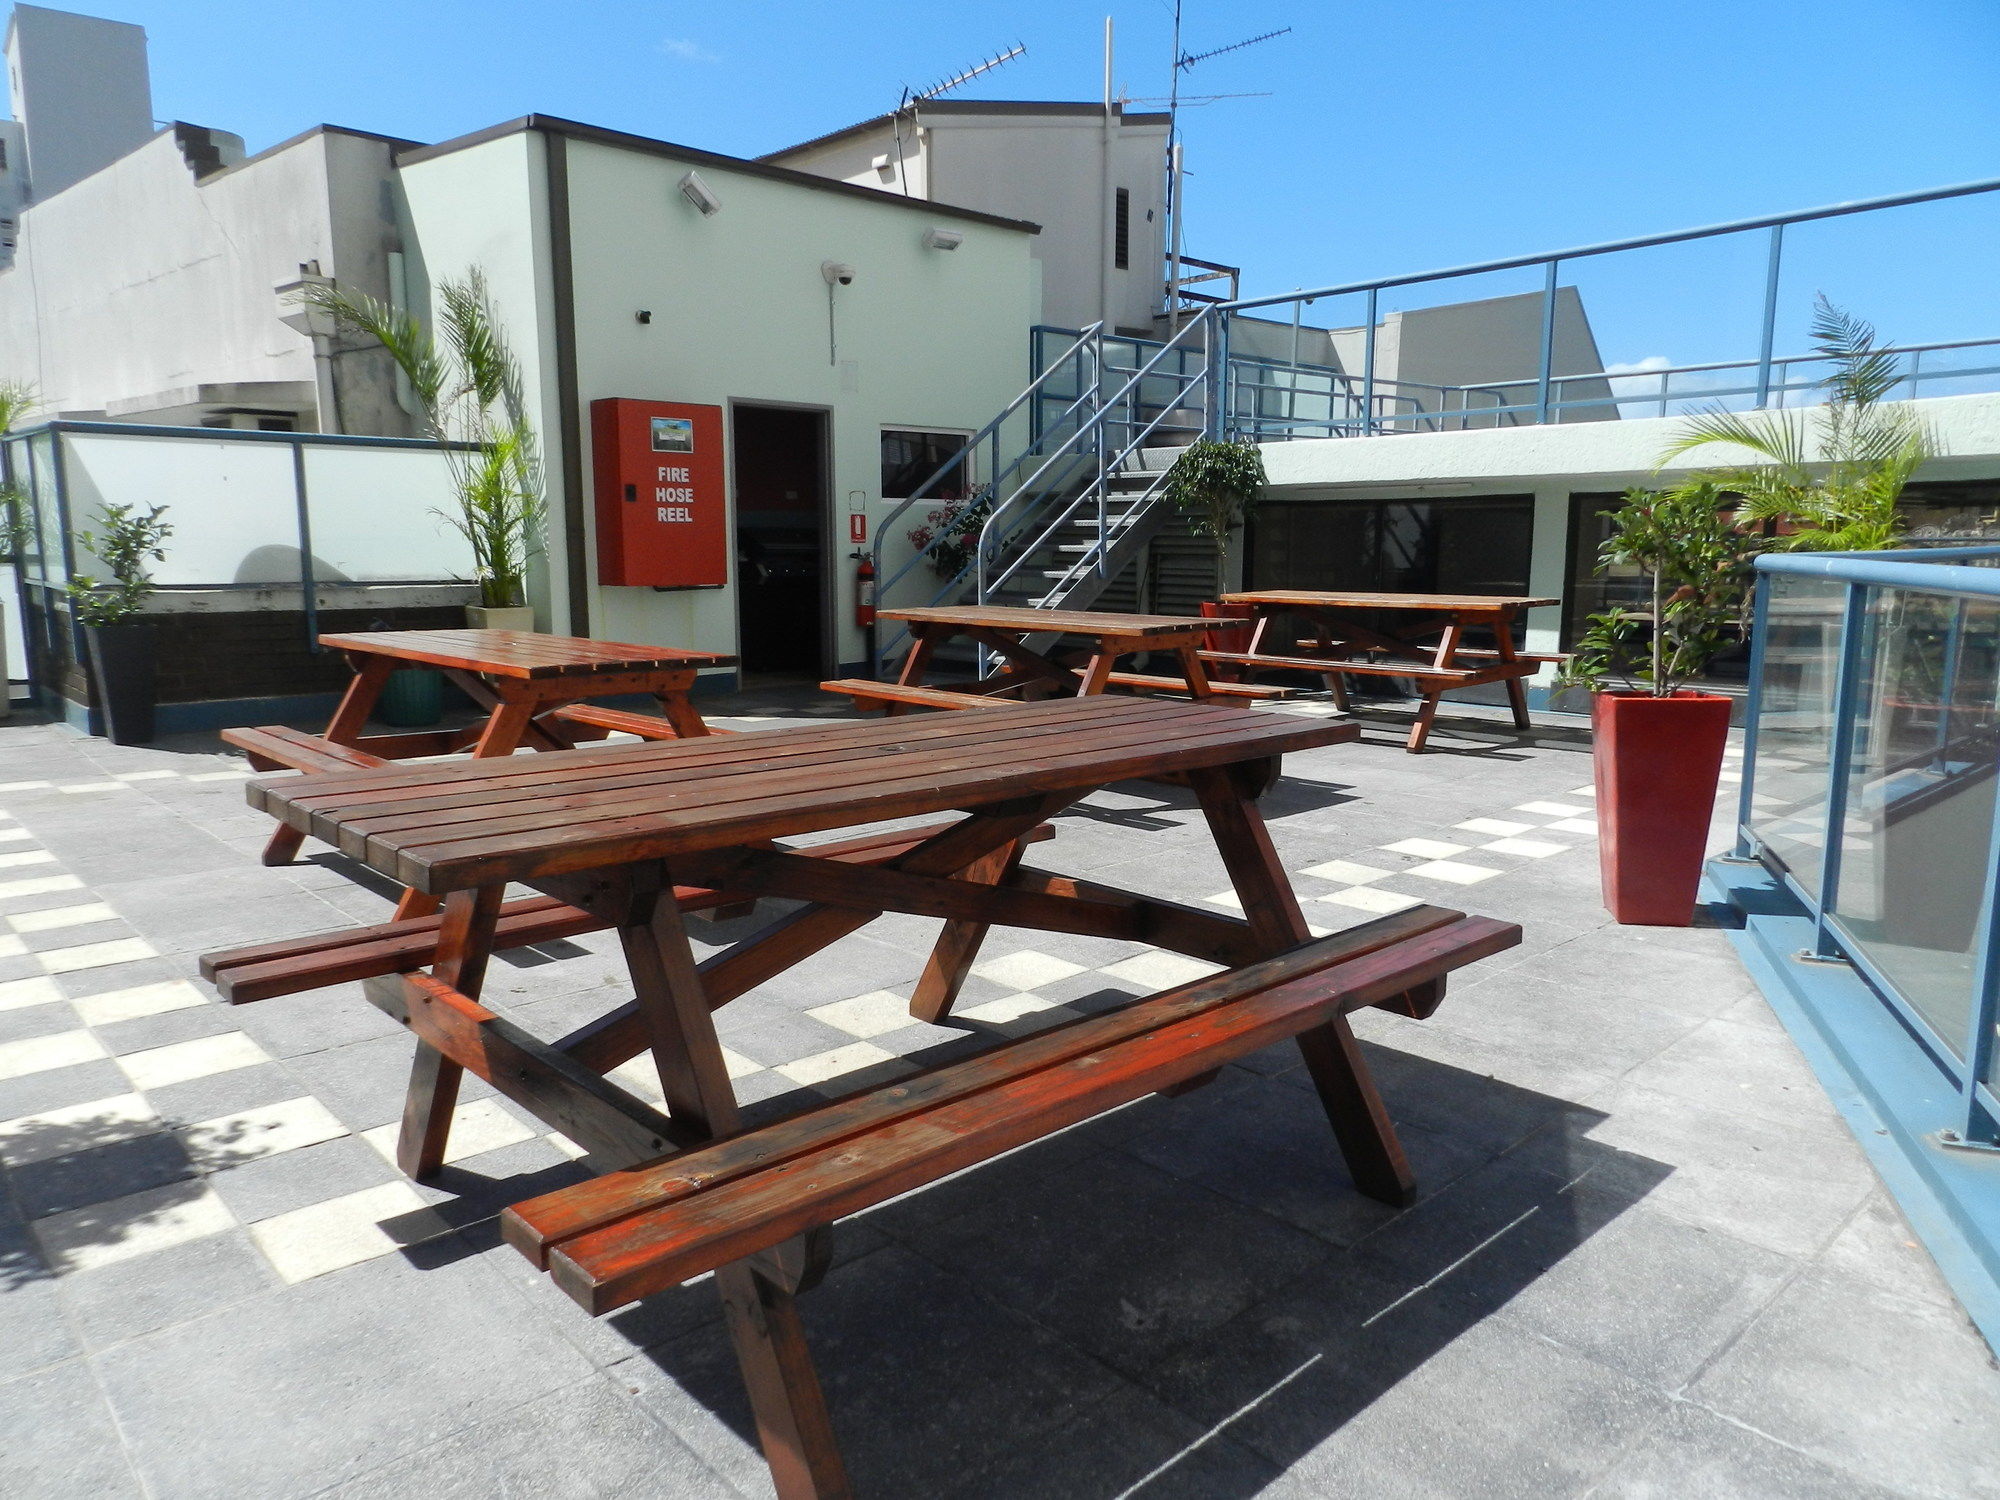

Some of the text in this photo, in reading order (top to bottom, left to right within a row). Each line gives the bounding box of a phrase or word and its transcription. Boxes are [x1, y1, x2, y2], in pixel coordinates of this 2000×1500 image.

[658, 467, 690, 483] FIRE
[655, 487, 694, 503] HOSE
[657, 507, 693, 522] REEL
